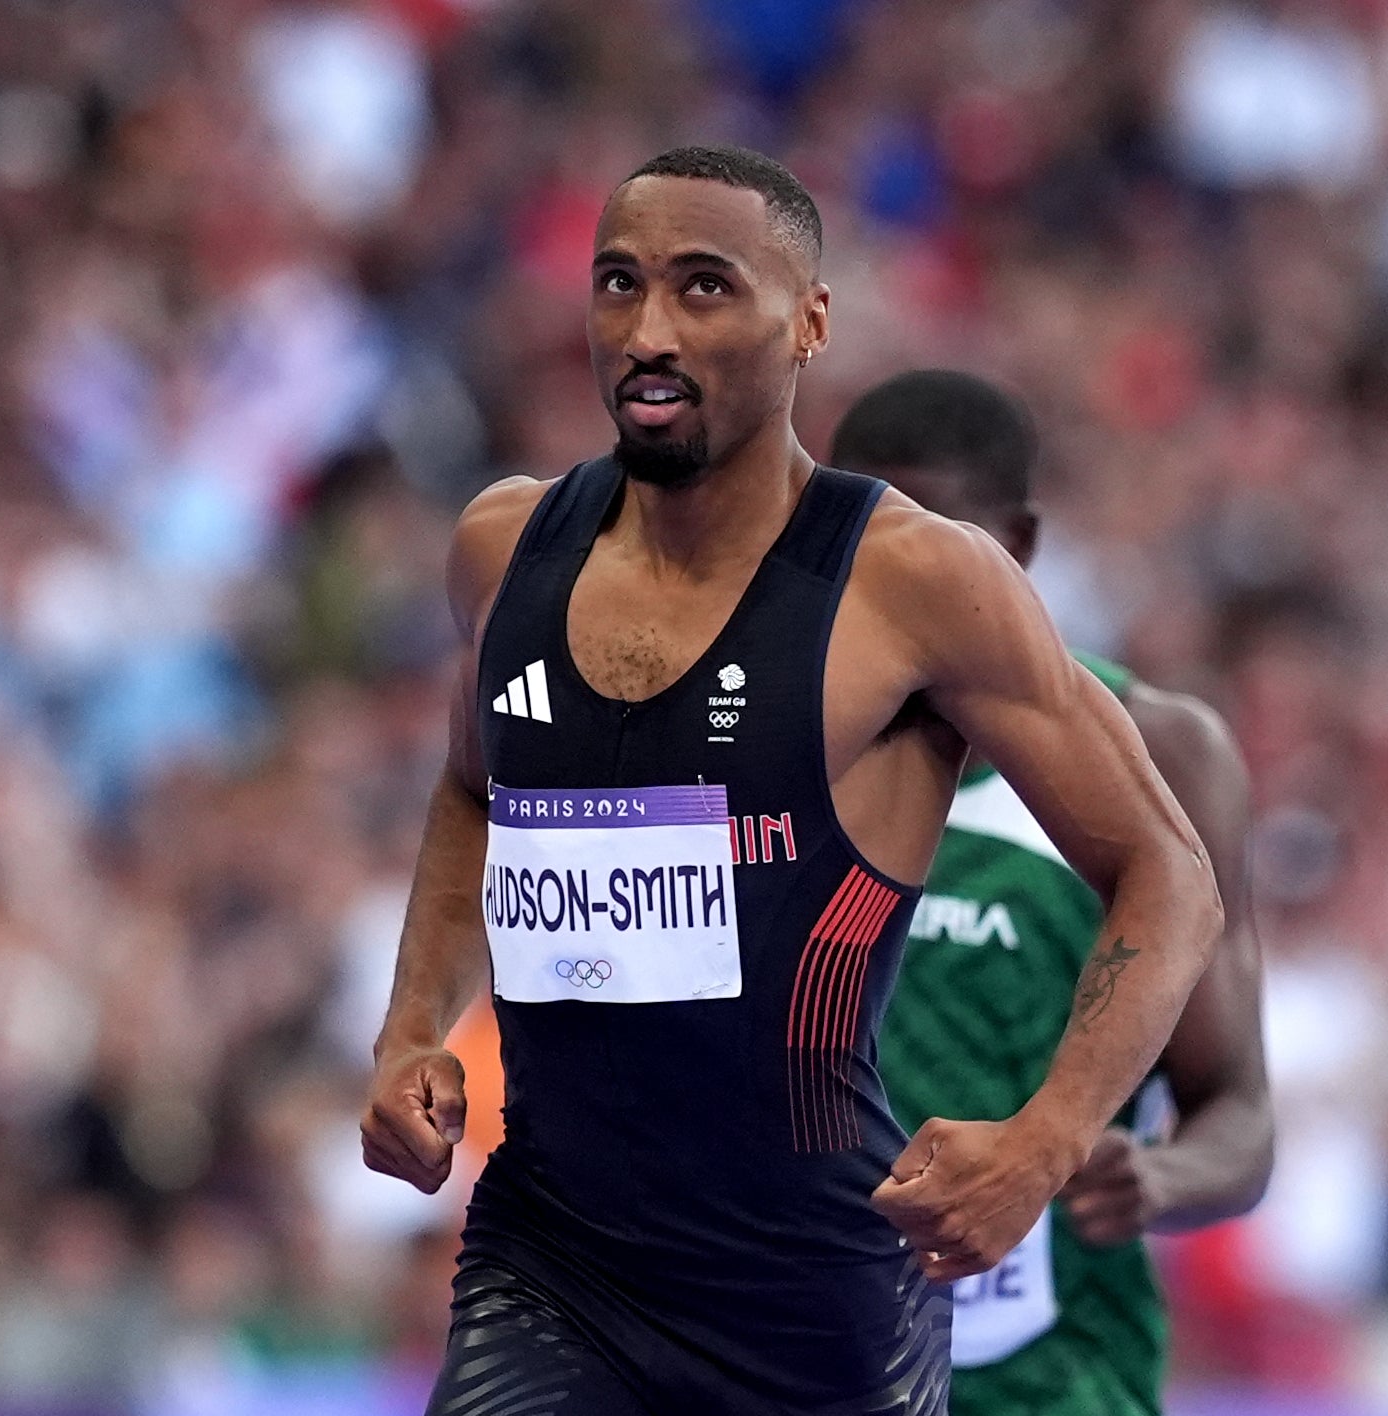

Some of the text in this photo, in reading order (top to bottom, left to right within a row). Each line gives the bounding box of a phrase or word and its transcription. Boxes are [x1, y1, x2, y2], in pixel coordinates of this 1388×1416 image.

[708, 697, 747, 707] TEAM GB
[508, 798, 646, 818] PARIS 2024
